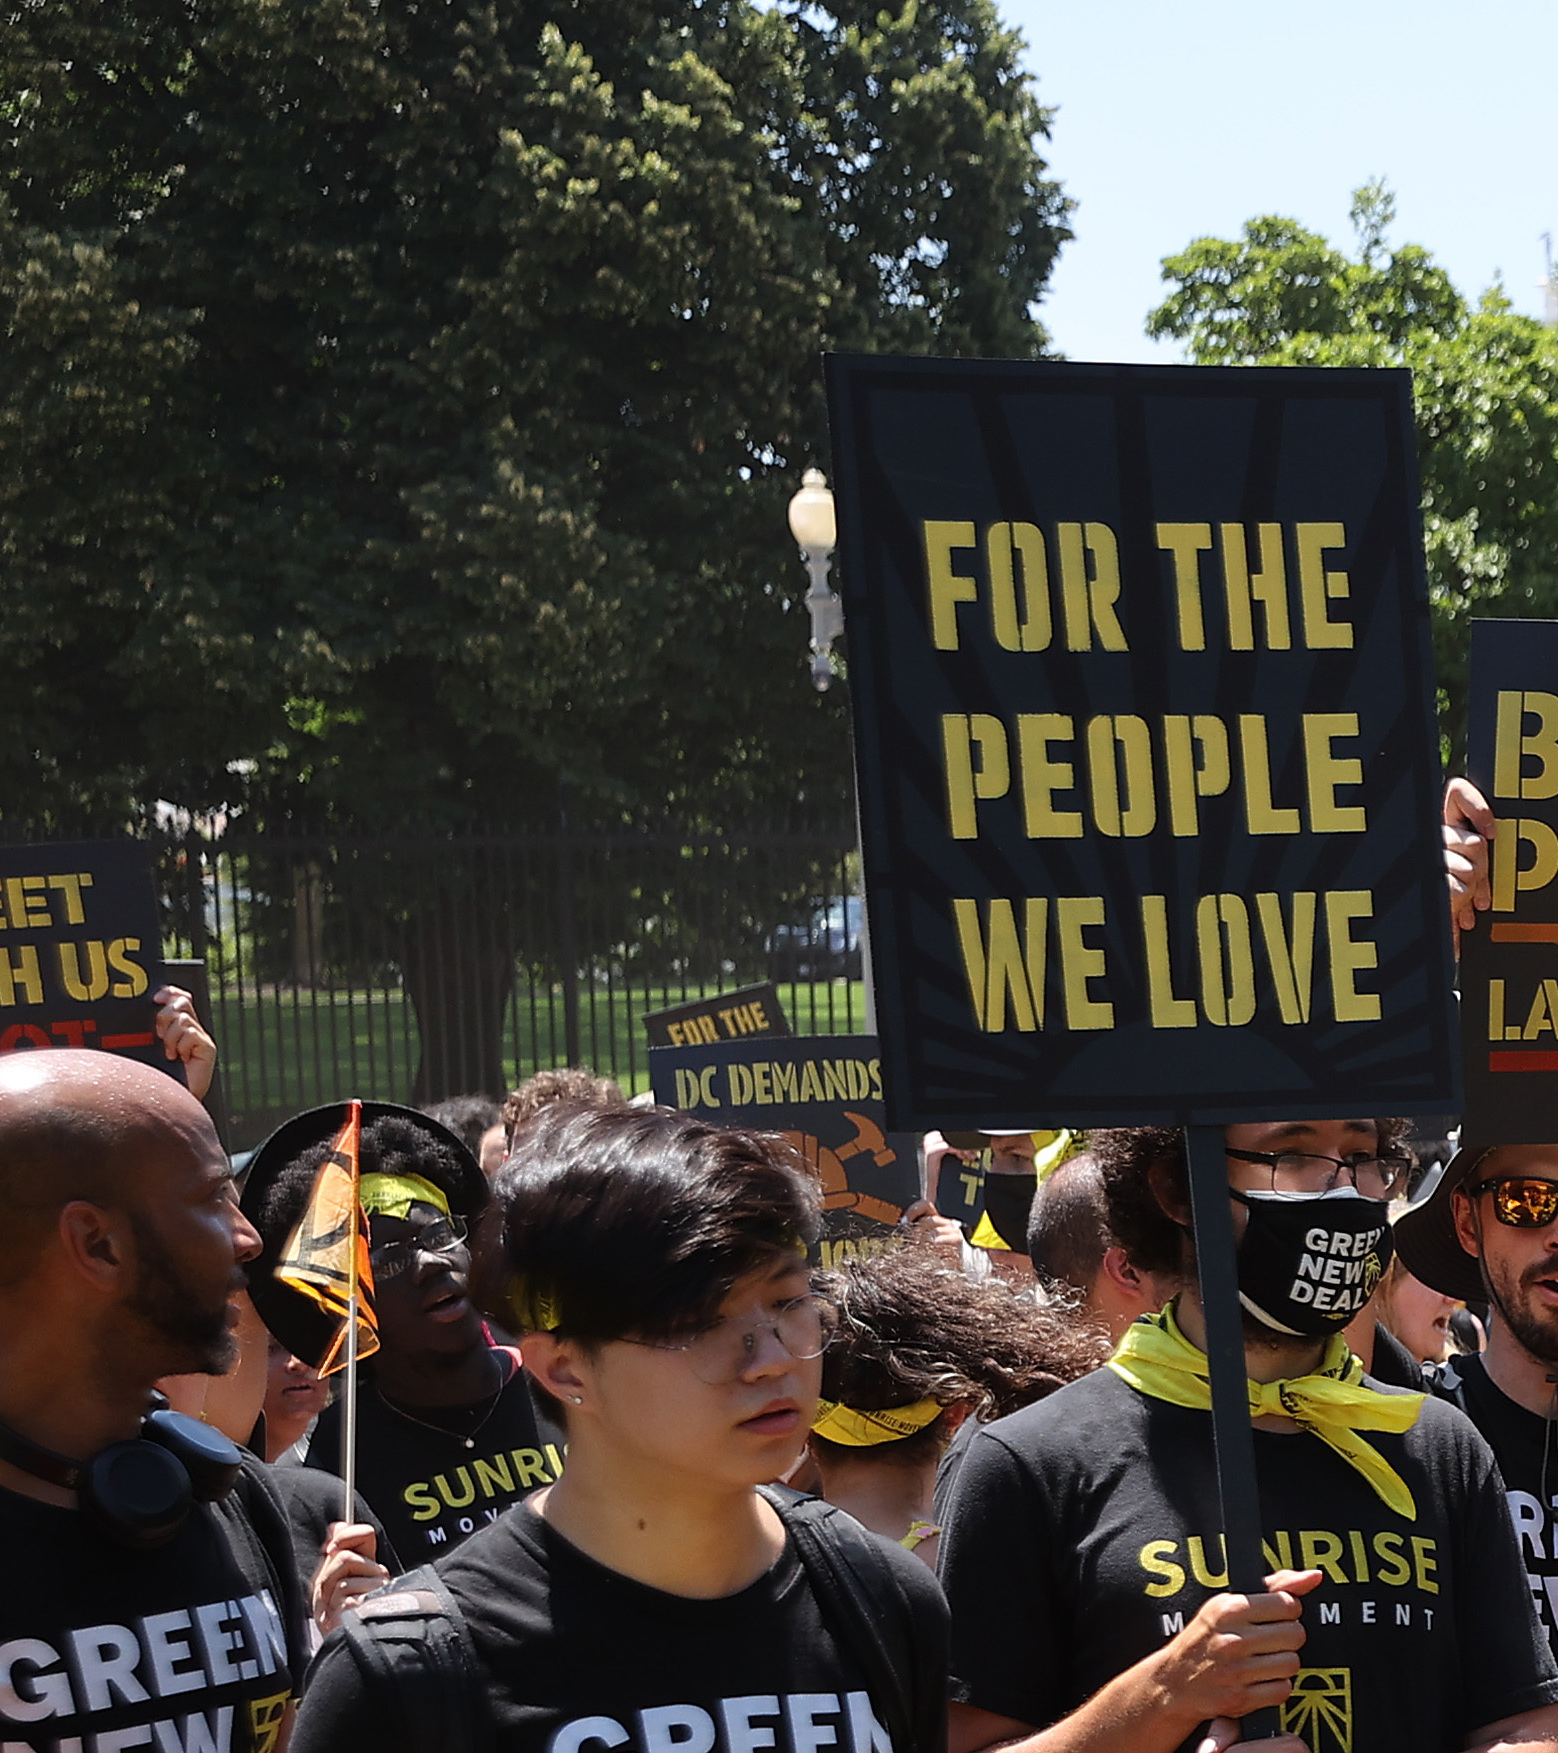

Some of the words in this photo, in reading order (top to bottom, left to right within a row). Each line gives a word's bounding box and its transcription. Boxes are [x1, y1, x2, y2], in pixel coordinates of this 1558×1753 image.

[924, 521, 1129, 653] FOR
[1156, 521, 1355, 650] THE
[942, 712, 1368, 839] PEOPLE
[0, 873, 94, 930] ET
[59, 937, 149, 1001] US
[953, 894, 1116, 1034] WE
[1142, 890, 1383, 1027] LOVE
[667, 1013, 721, 1047] FOR
[717, 1001, 770, 1036] THE
[675, 1064, 721, 1110] DC
[727, 1058, 885, 1106] DEMANDS
[1289, 1278, 1364, 1311] DEAL
[1297, 1252, 1366, 1285] NEW
[404, 1443, 569, 1522] SUNRI
[1139, 1530, 1440, 1598] SUNRISE
[1162, 1601, 1434, 1637] MMENT
[1, 1588, 291, 1723] GREEN
